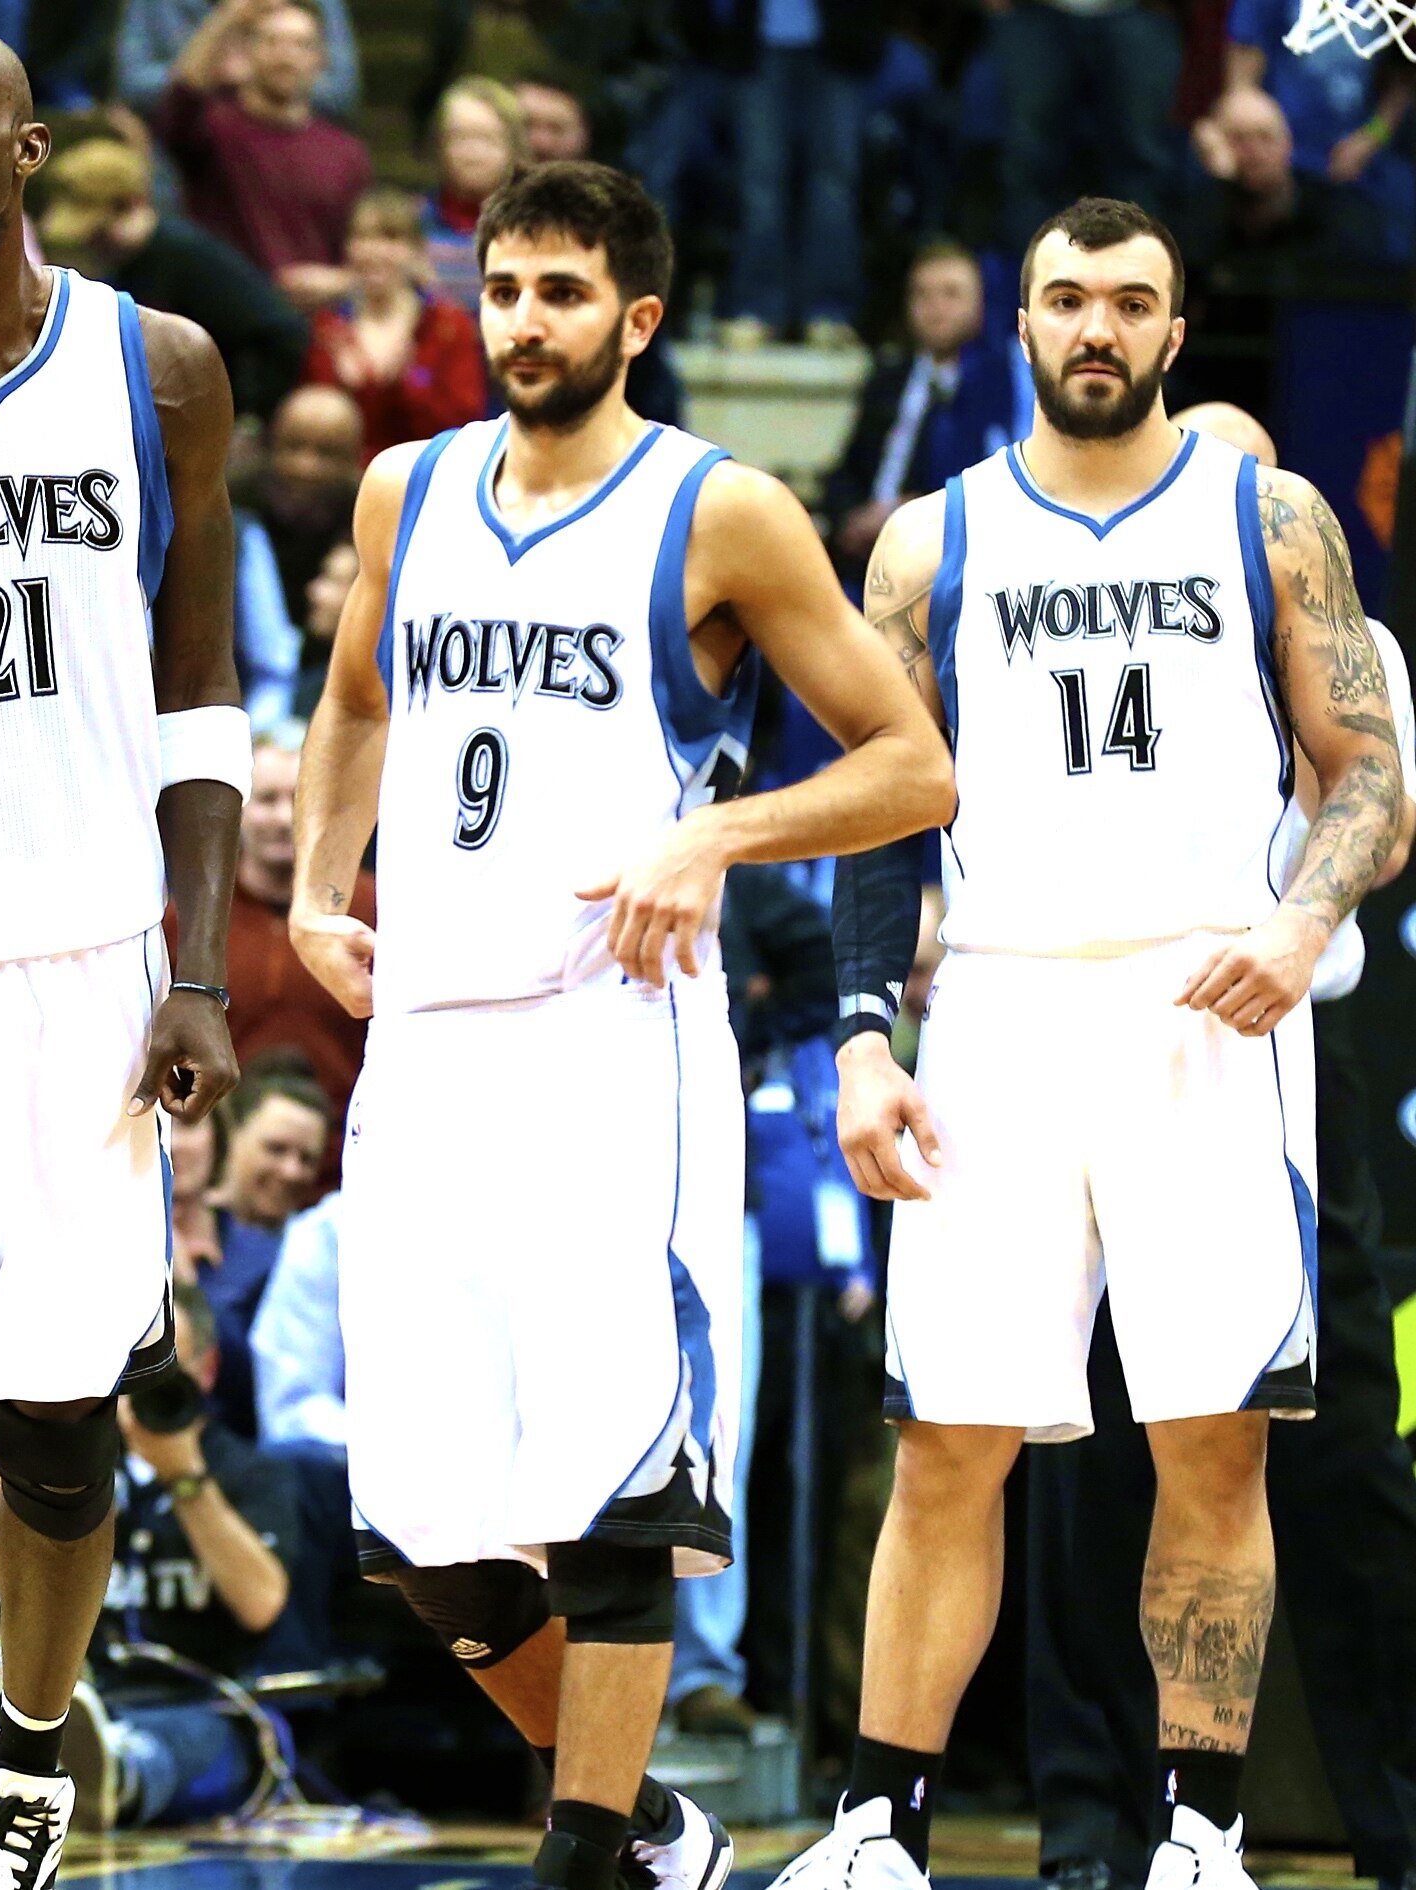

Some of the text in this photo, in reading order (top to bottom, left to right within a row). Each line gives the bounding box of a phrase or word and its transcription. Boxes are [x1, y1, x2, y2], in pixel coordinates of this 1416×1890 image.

[402, 612, 626, 716] WOLVES
[985, 573, 1225, 667] WOLVES
[1049, 663, 1163, 775] 14
[453, 727, 510, 851] 9
